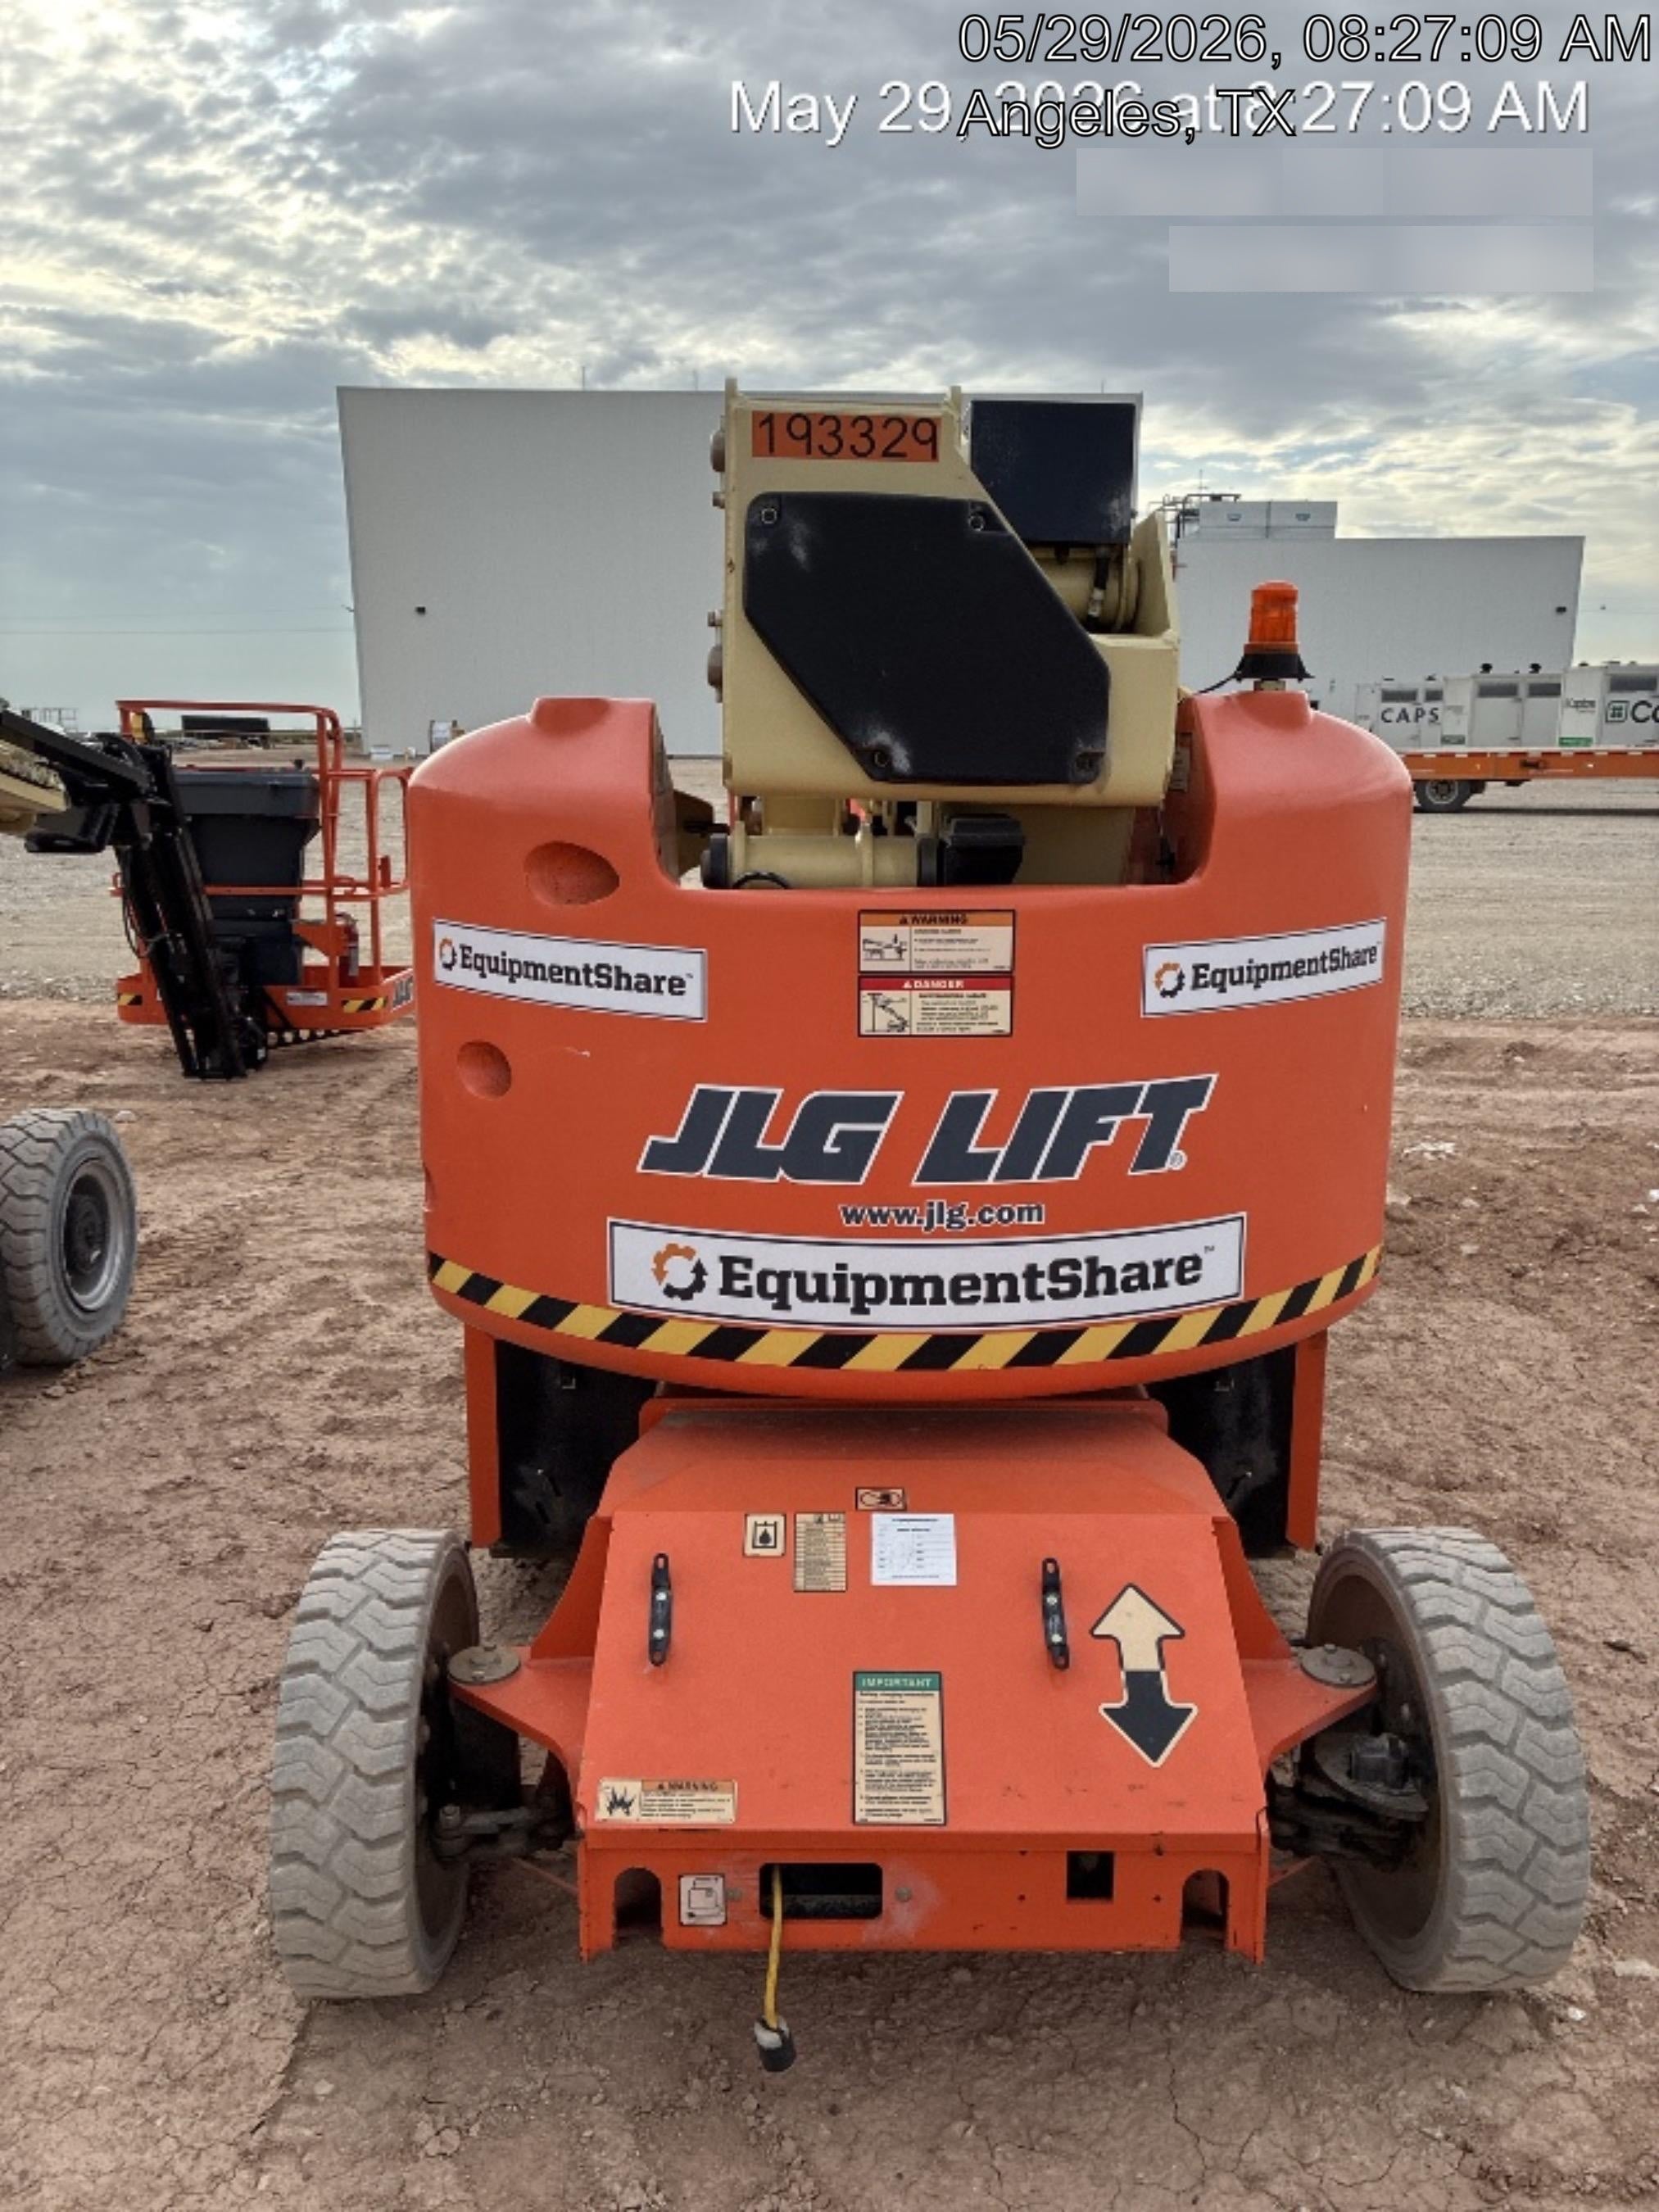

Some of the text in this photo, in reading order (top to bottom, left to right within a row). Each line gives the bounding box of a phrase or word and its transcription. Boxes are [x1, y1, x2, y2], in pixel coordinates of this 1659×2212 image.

[759, 413, 937, 460] 193329
[1380, 707, 1439, 723] CAPS
[460, 944, 687, 996] EquipmentShare
[913, 981, 964, 989] DANGER
[1192, 943, 1378, 993] EquipmentShare
[637, 1084, 904, 1185] JLG
[839, 1199, 1045, 1233] www.jlg.com
[718, 1253, 1203, 1314] EquipmentShare
[862, 1678, 932, 1687] IMPORTANT
